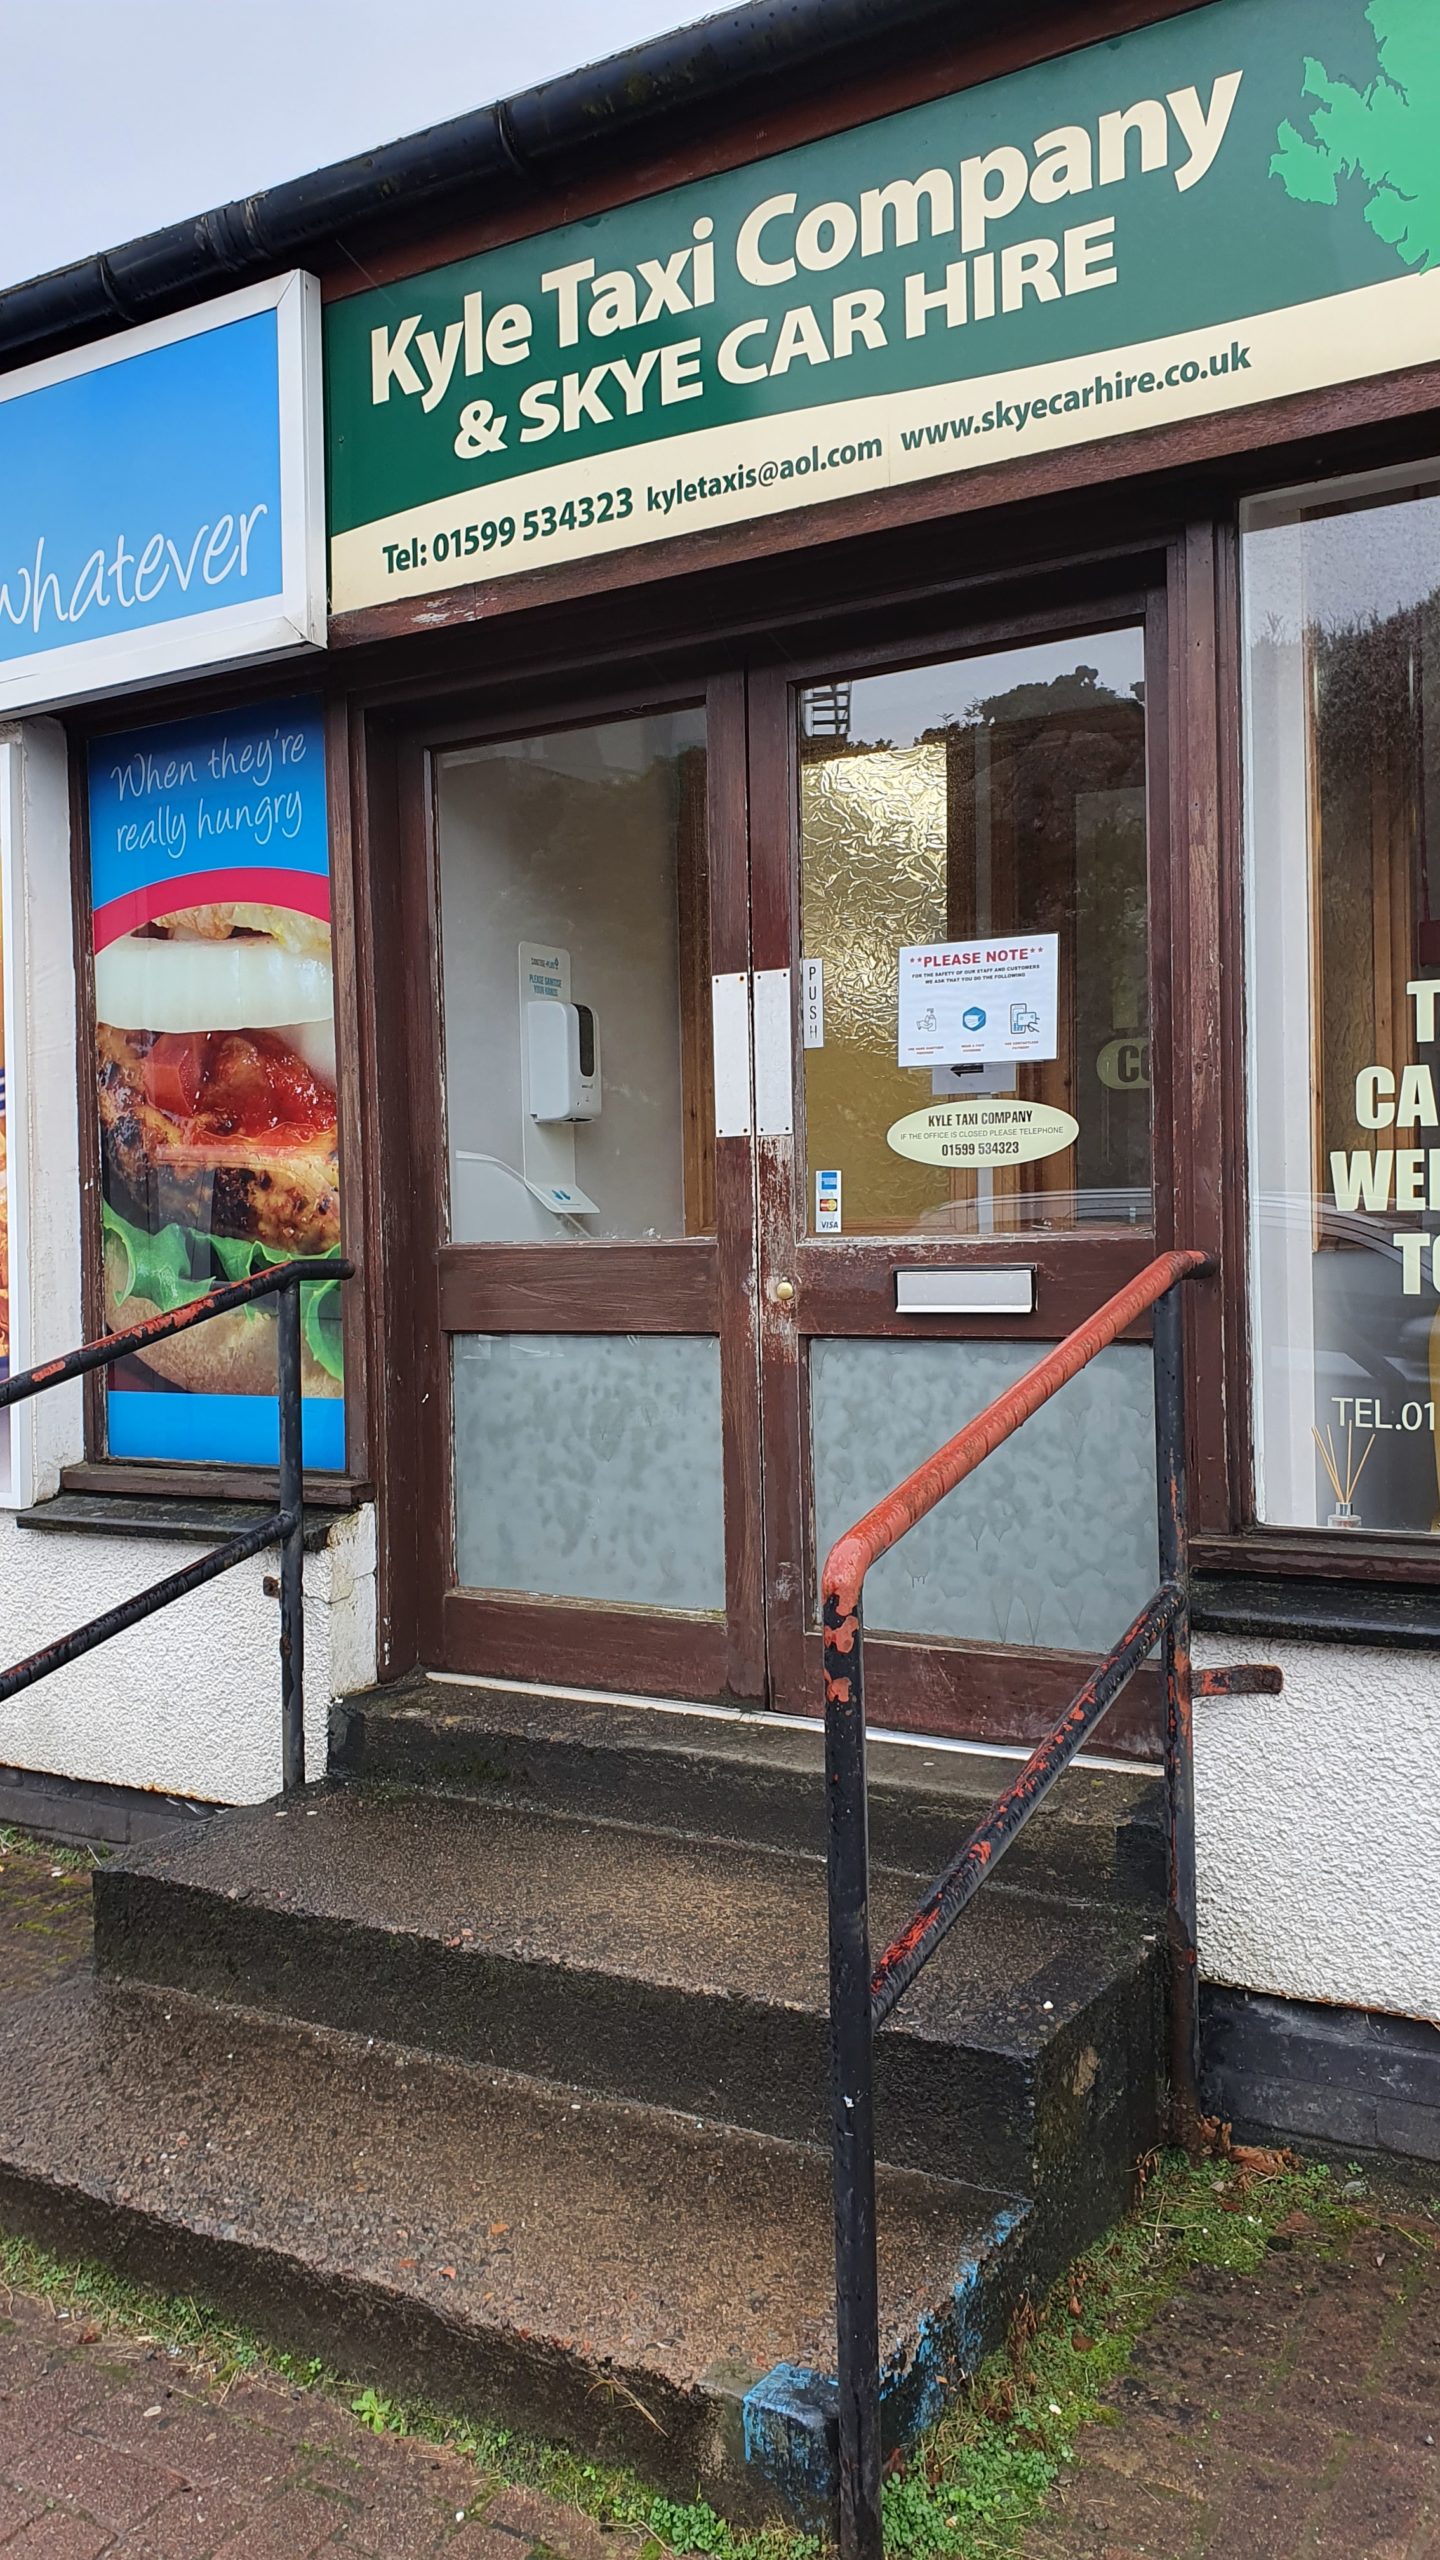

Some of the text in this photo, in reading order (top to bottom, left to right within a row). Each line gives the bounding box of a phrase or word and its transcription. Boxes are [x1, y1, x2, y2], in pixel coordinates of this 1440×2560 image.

[371, 69, 1244, 414] Kyle Taxi Company
[453, 215, 1118, 460] & SKYE CAR HIRE
[382, 341, 1252, 574] Tel: 01599 534323 kyletaxis@aol.com www.skyecarhire.co.uk
[110, 729, 307, 802] When they're
[117, 790, 303, 859] really hungry
[808, 966, 818, 1039] PUSH
[923, 1131, 949, 1139] OFFICE
[958, 1130, 988, 1138] CLOSED
[989, 1128, 1017, 1136] PLEASE
[1020, 1126, 1064, 1135] TELEPHONE
[928, 1110, 1033, 1127] KYLE TAXI COMPANY
[941, 1141, 1019, 1156] 01599 534323
[821, 1221, 839, 1229] VISA
